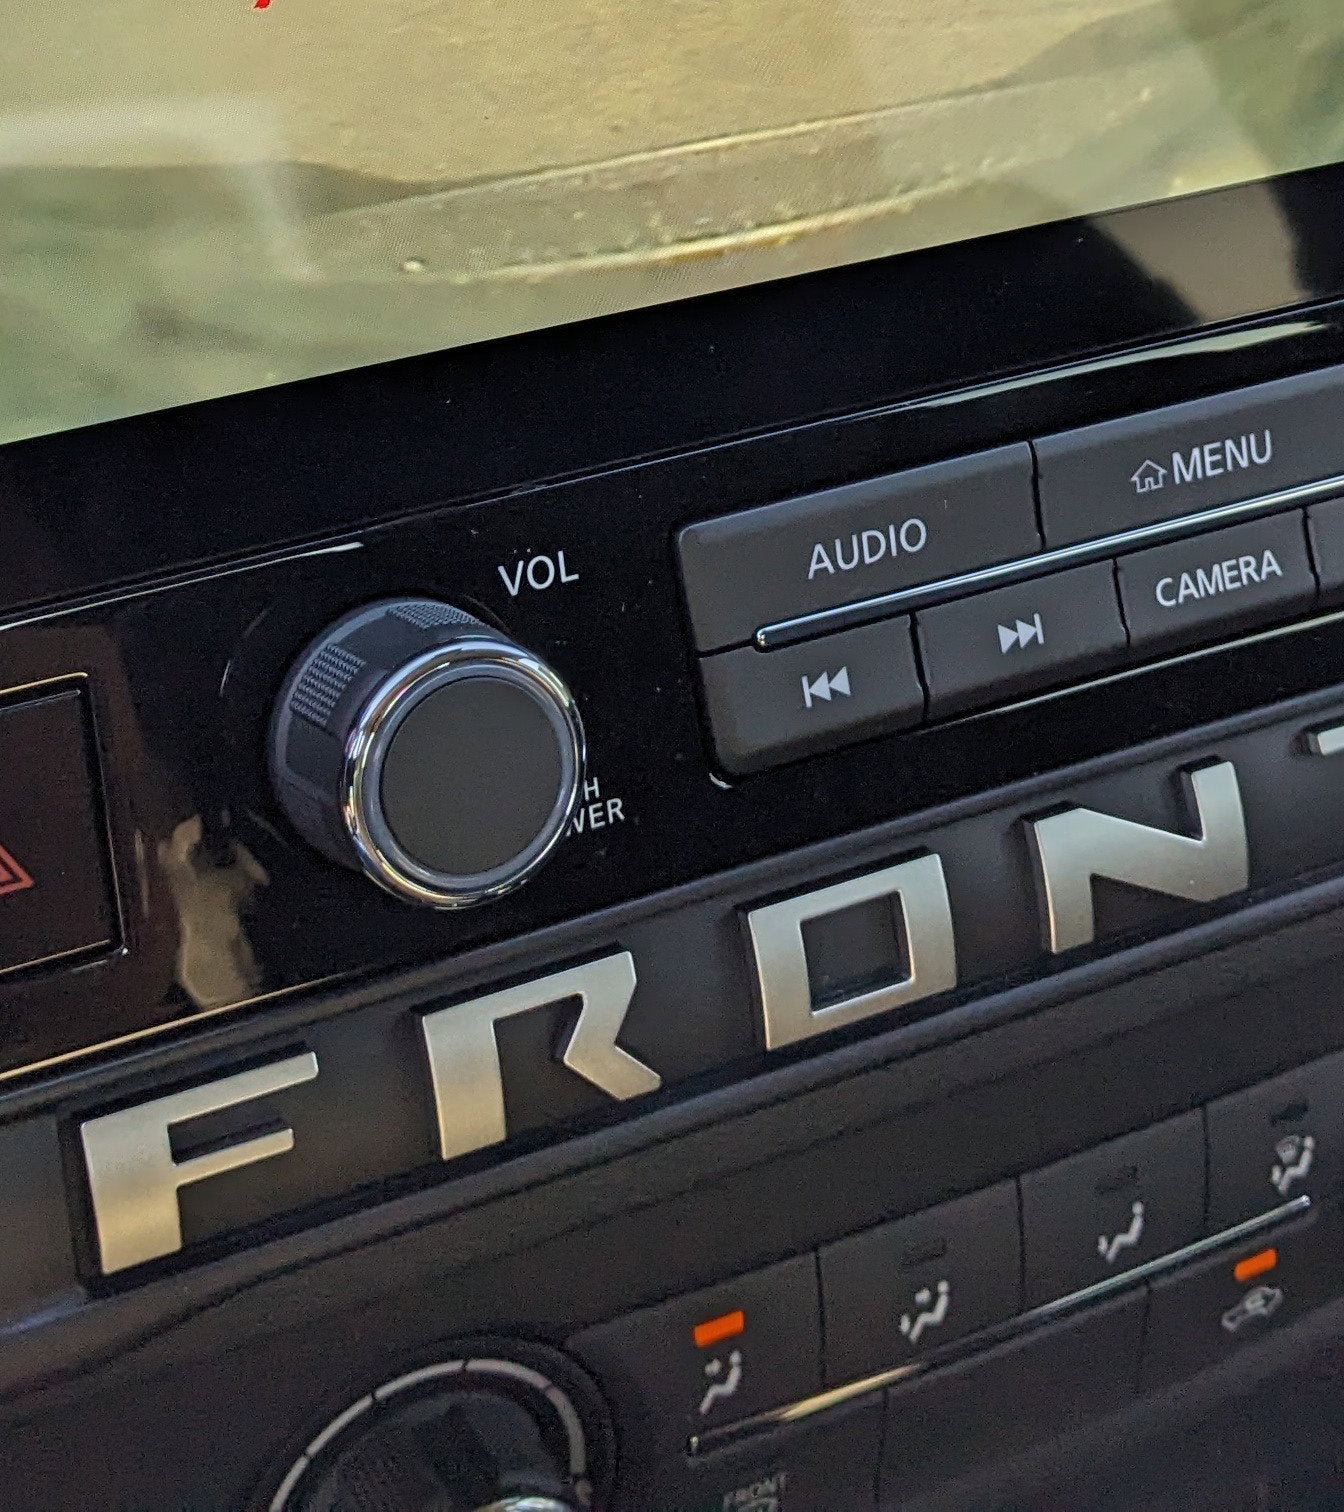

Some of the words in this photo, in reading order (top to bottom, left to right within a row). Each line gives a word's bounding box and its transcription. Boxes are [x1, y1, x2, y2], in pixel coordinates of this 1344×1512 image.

[1171, 429, 1273, 485] MENU
[498, 550, 579, 597] VOL
[807, 519, 927, 580] AUDIO
[1156, 550, 1283, 609] CAMERA
[567, 797, 625, 837] WER
